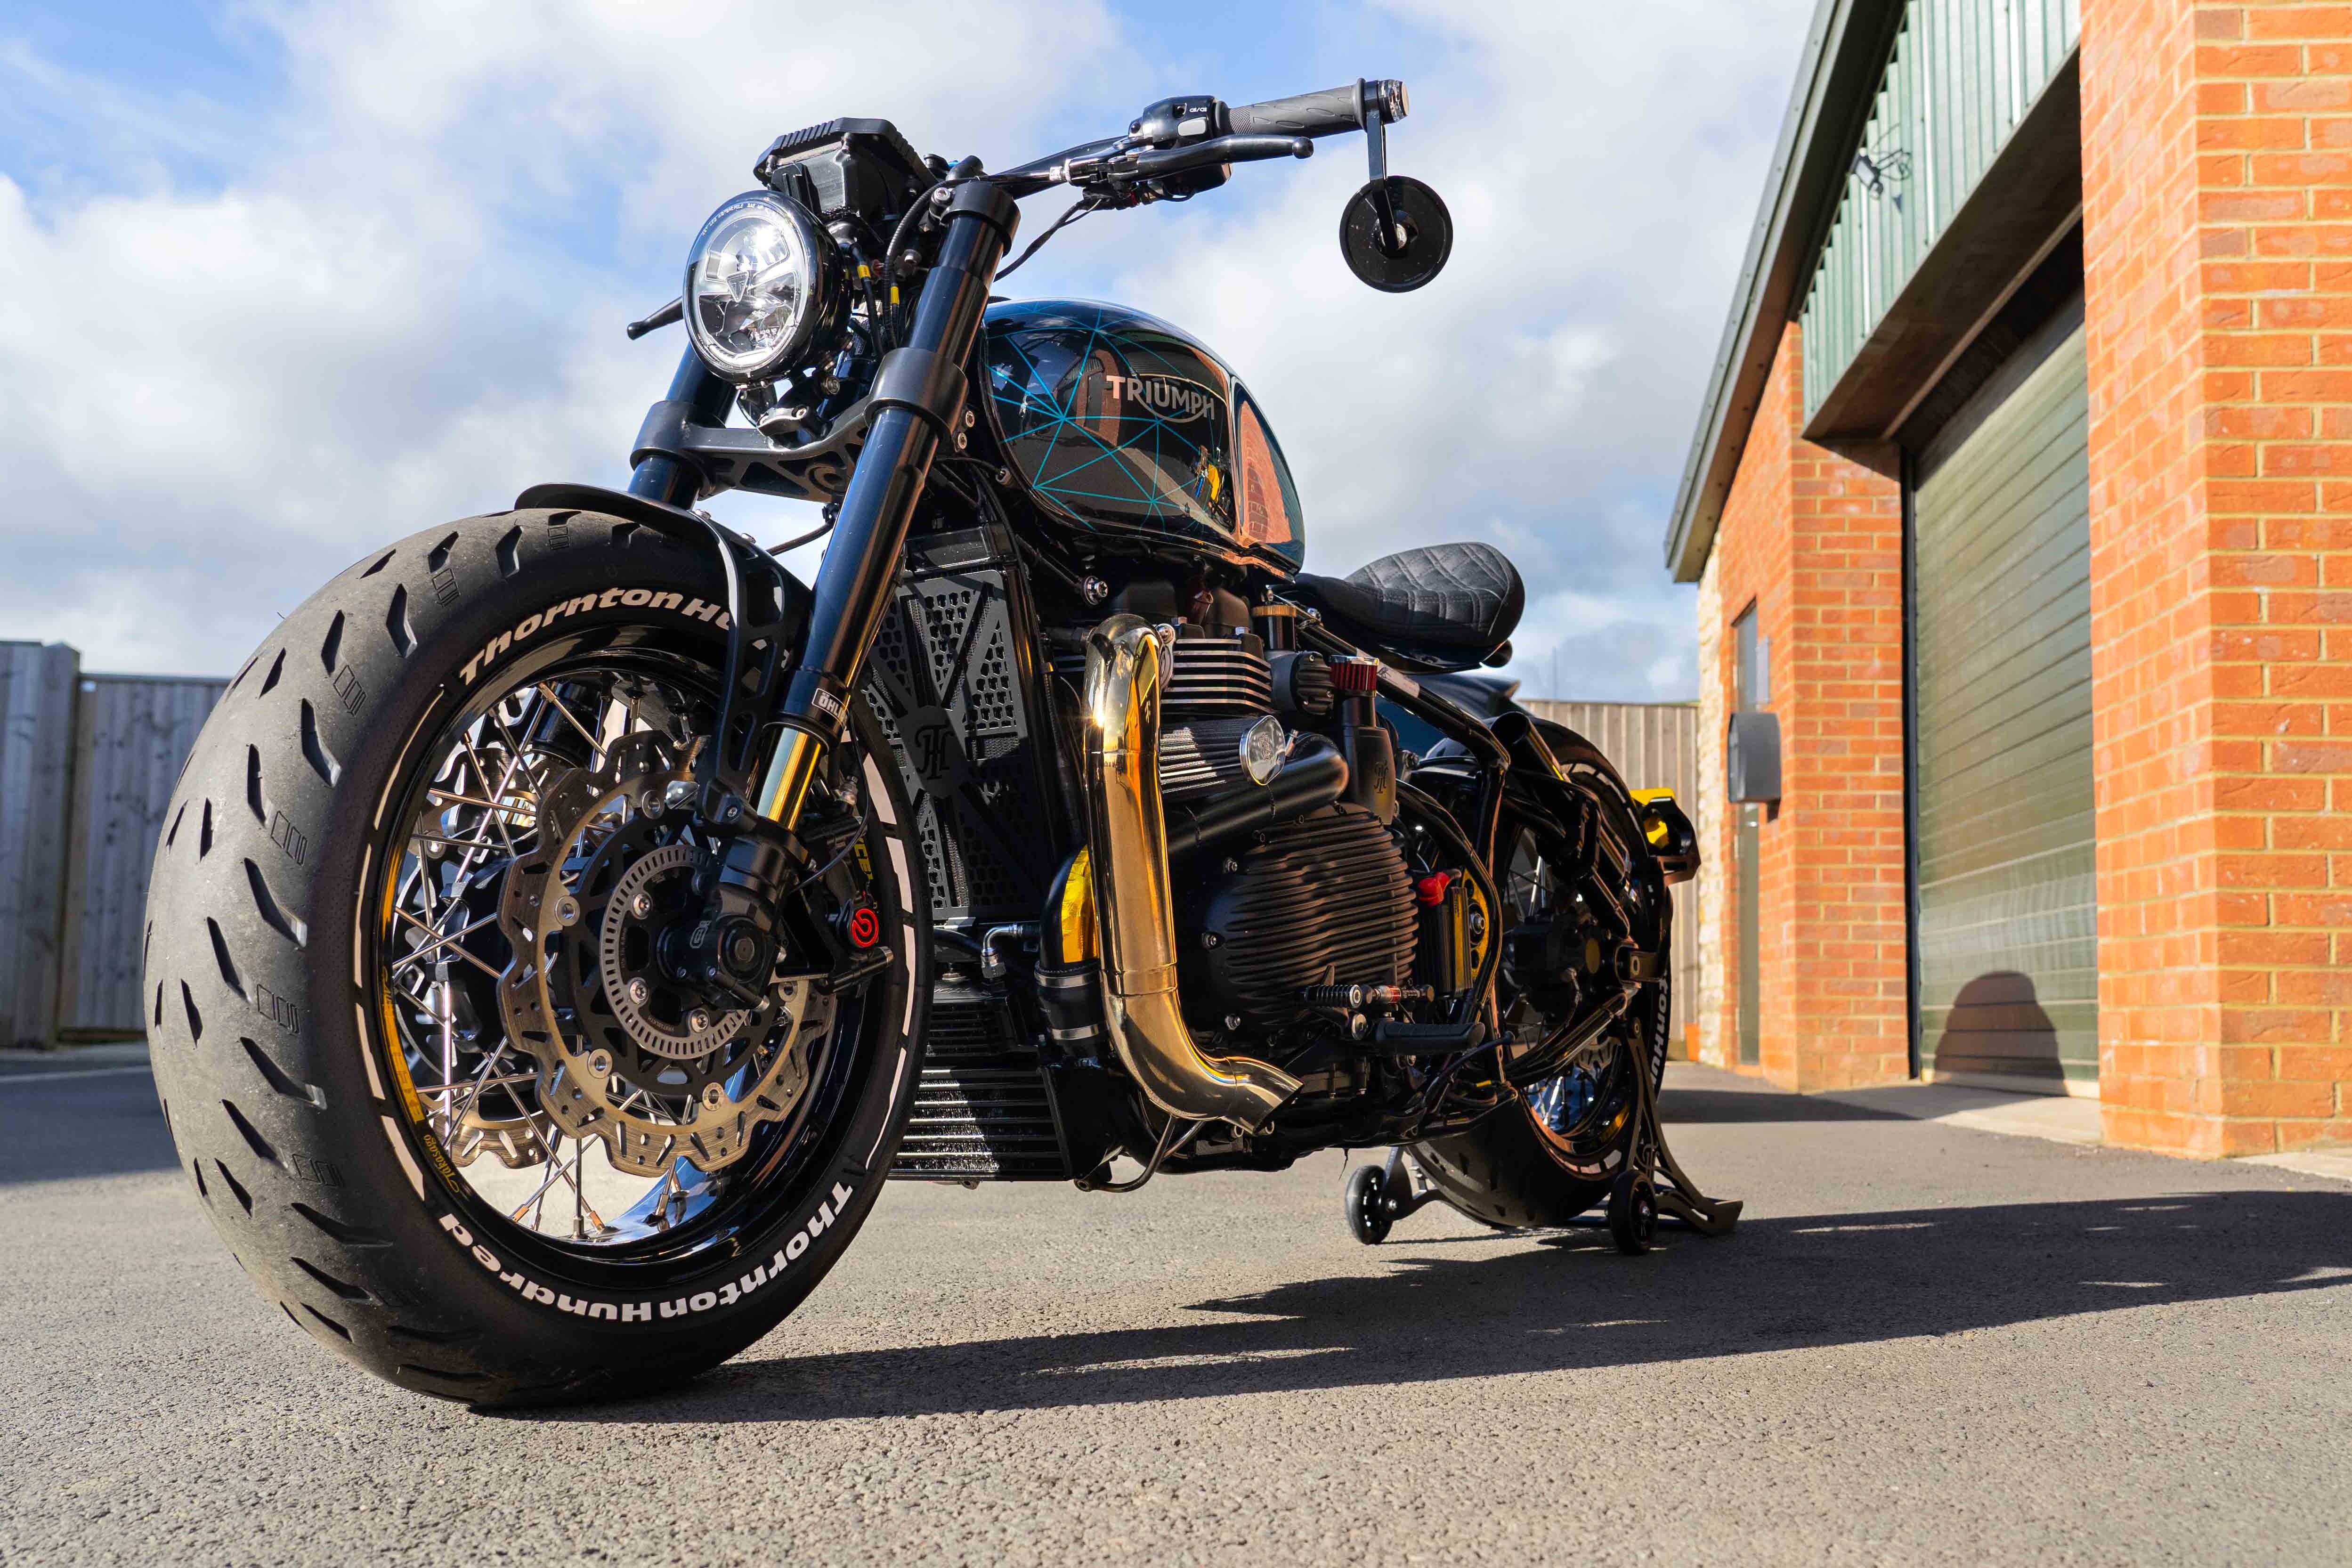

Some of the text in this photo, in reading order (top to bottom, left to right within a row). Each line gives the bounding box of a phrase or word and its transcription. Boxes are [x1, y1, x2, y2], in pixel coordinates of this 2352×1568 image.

[1106, 375, 1215, 423] TRIUMPH
[459, 587, 683, 686] Thornton
[423, 1134, 460, 1194] Takasago
[438, 1181, 853, 1322] Thornton Hundred
